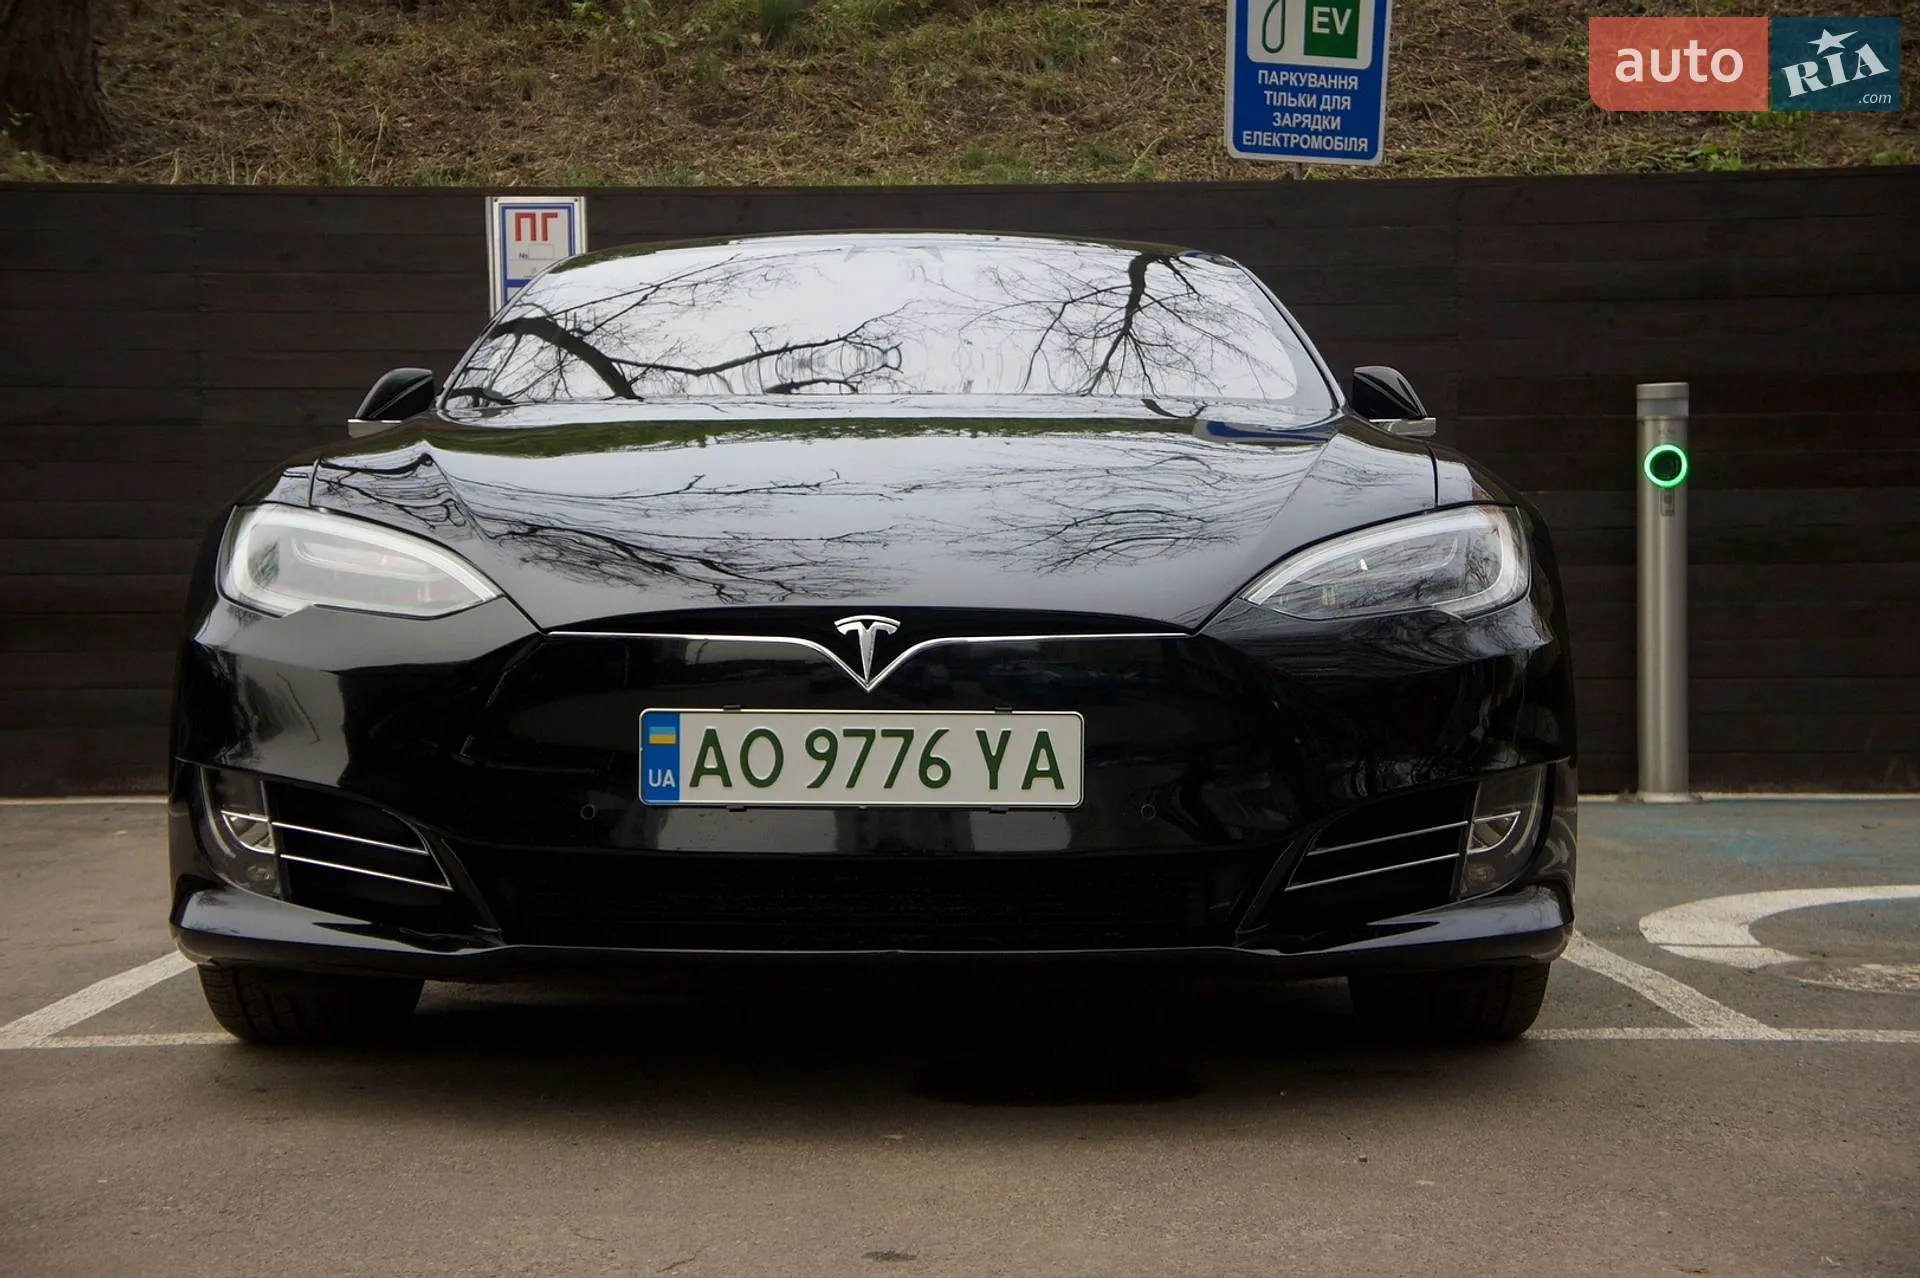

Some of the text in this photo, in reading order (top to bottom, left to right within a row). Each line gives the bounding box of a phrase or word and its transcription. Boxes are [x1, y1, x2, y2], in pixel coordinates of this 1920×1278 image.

[1311, 6, 1352, 35] EV
[1258, 69, 1358, 90] ПАРКУВАННЯ
[1264, 90, 1352, 111] ТІЛЬКИ ДЛЯ
[1272, 112, 1341, 131] ЗАРЯДКИ
[1242, 130, 1368, 152] ЕЛЕКТРОМОБІЛЯ
[515, 212, 558, 241] ПГ
[689, 727, 1065, 790] AO 9776 YA
[648, 770, 676, 787] UA
